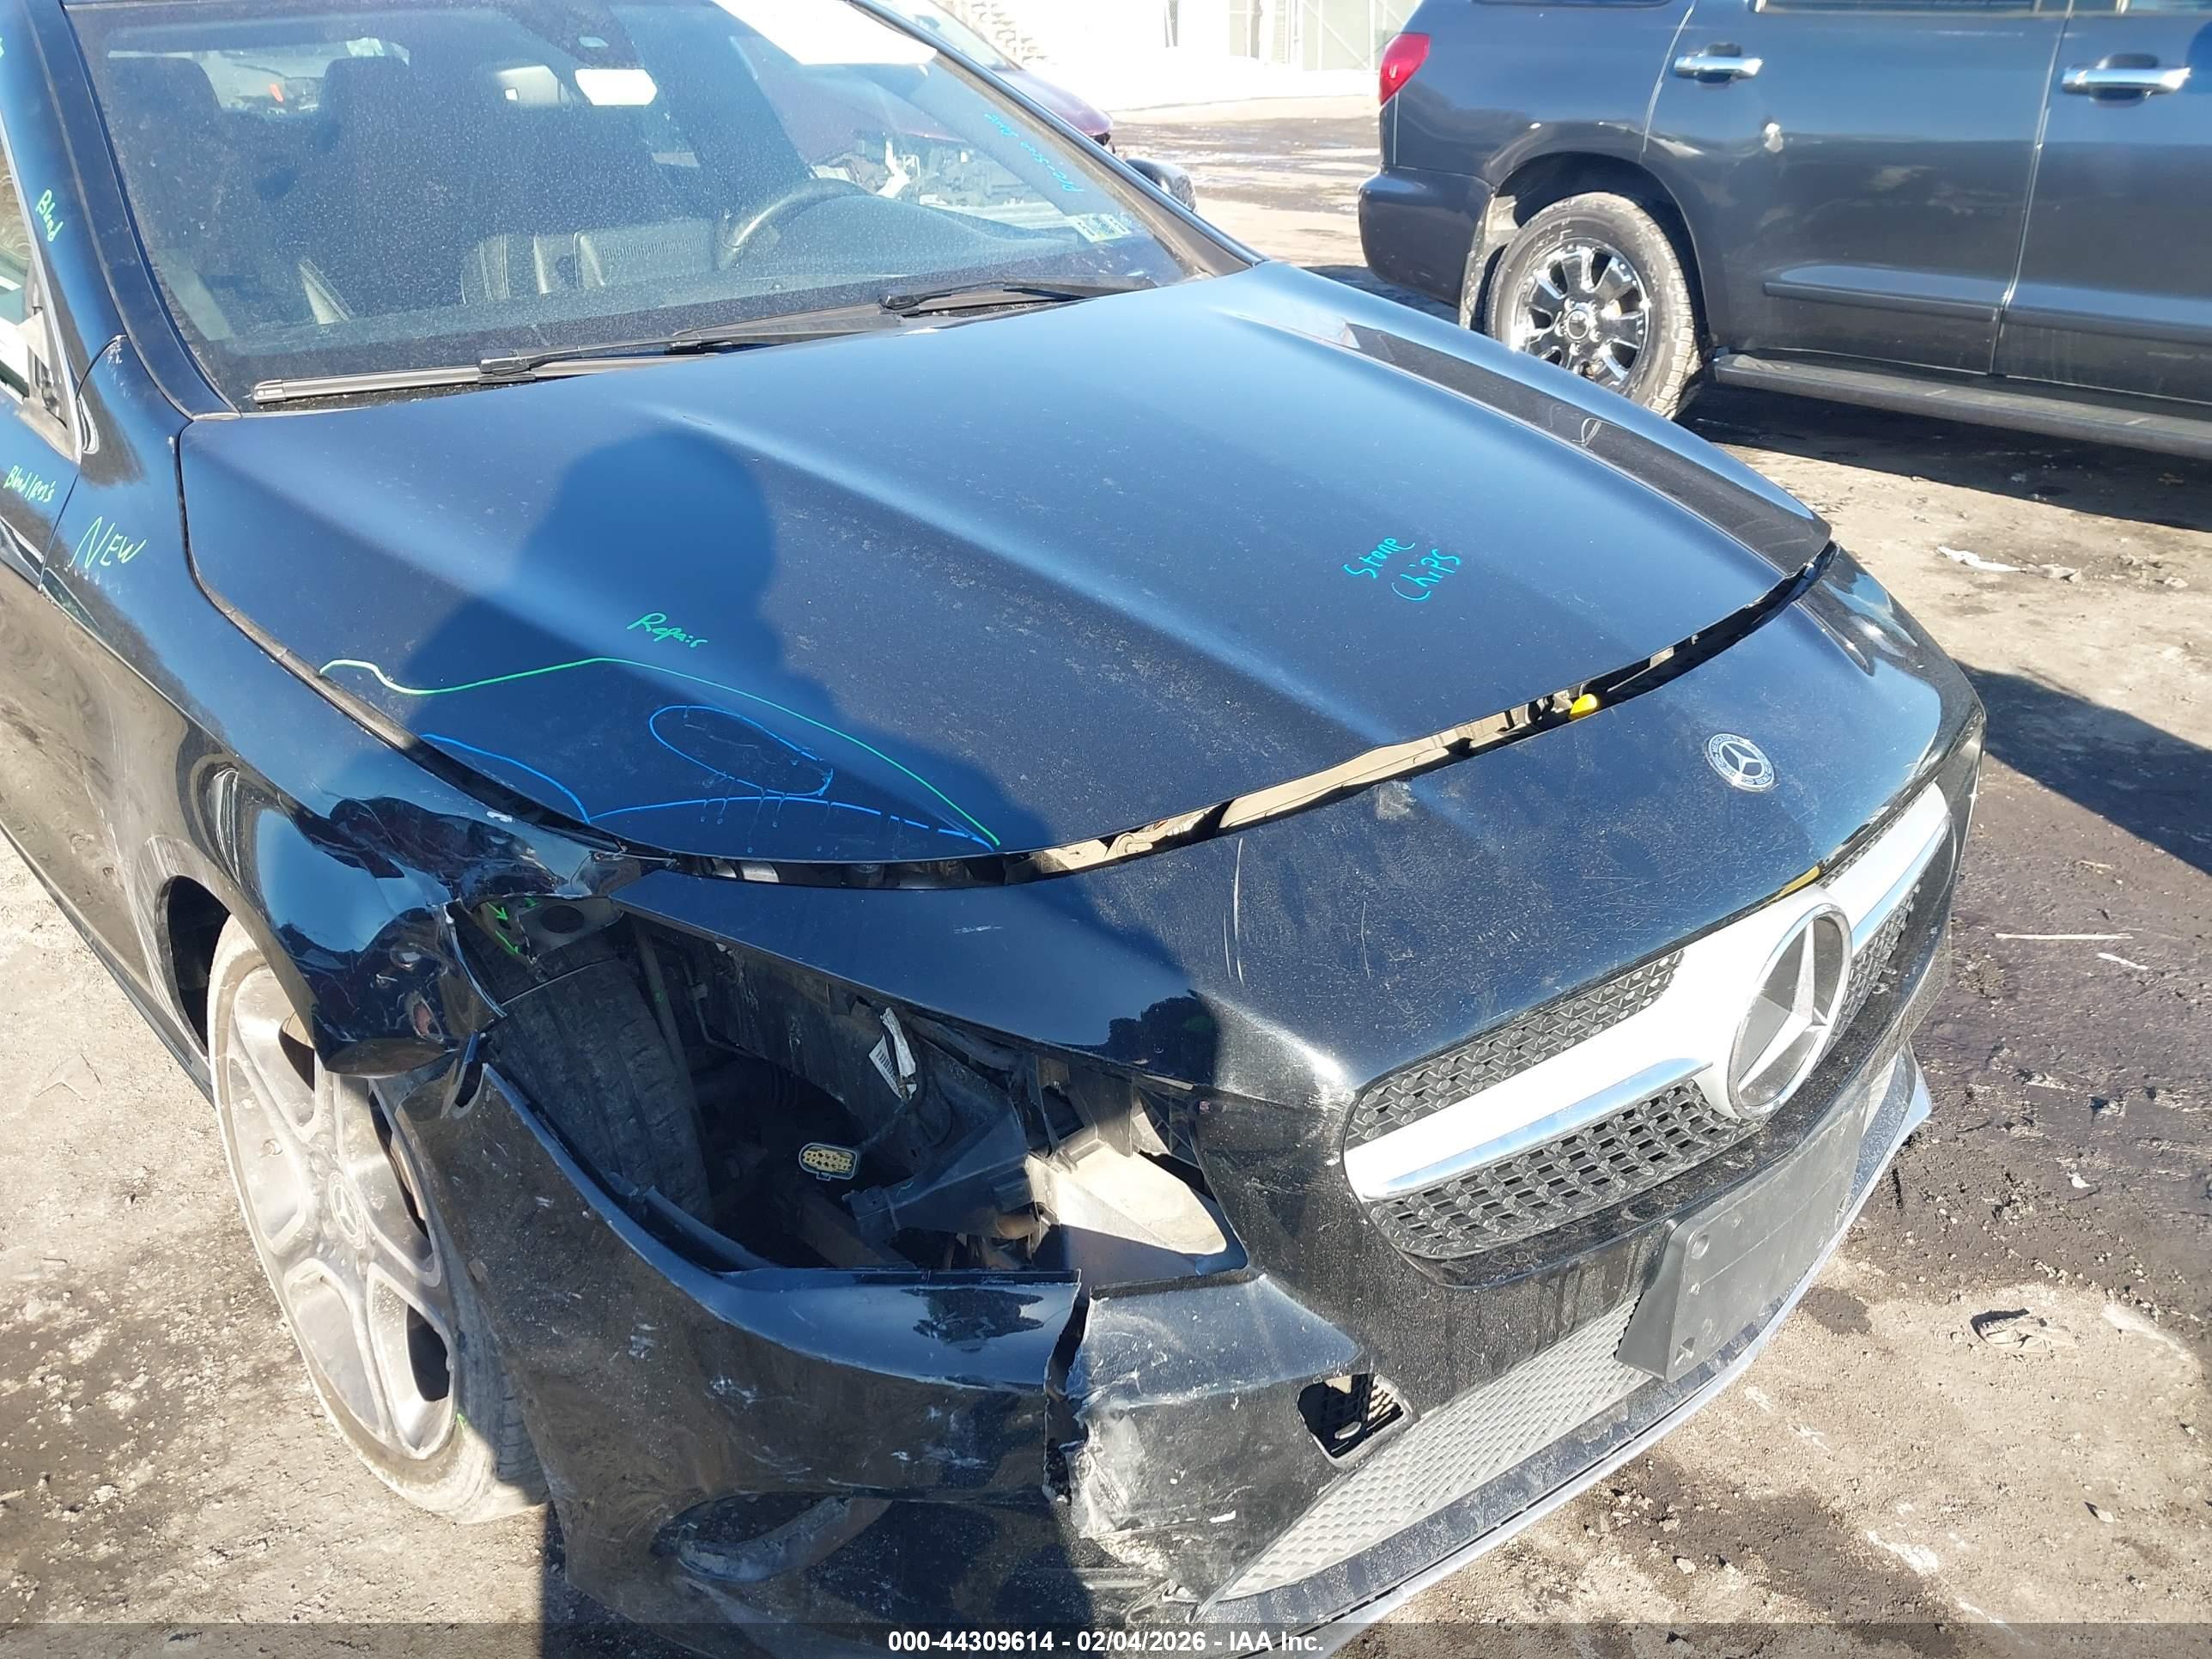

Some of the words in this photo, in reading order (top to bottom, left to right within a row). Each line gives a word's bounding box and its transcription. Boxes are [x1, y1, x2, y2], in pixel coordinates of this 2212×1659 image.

[35, 189, 64, 241] Blend
[68, 516, 147, 568] NEW
[1343, 538, 1416, 578] Stone
[626, 612, 708, 647] Repair
